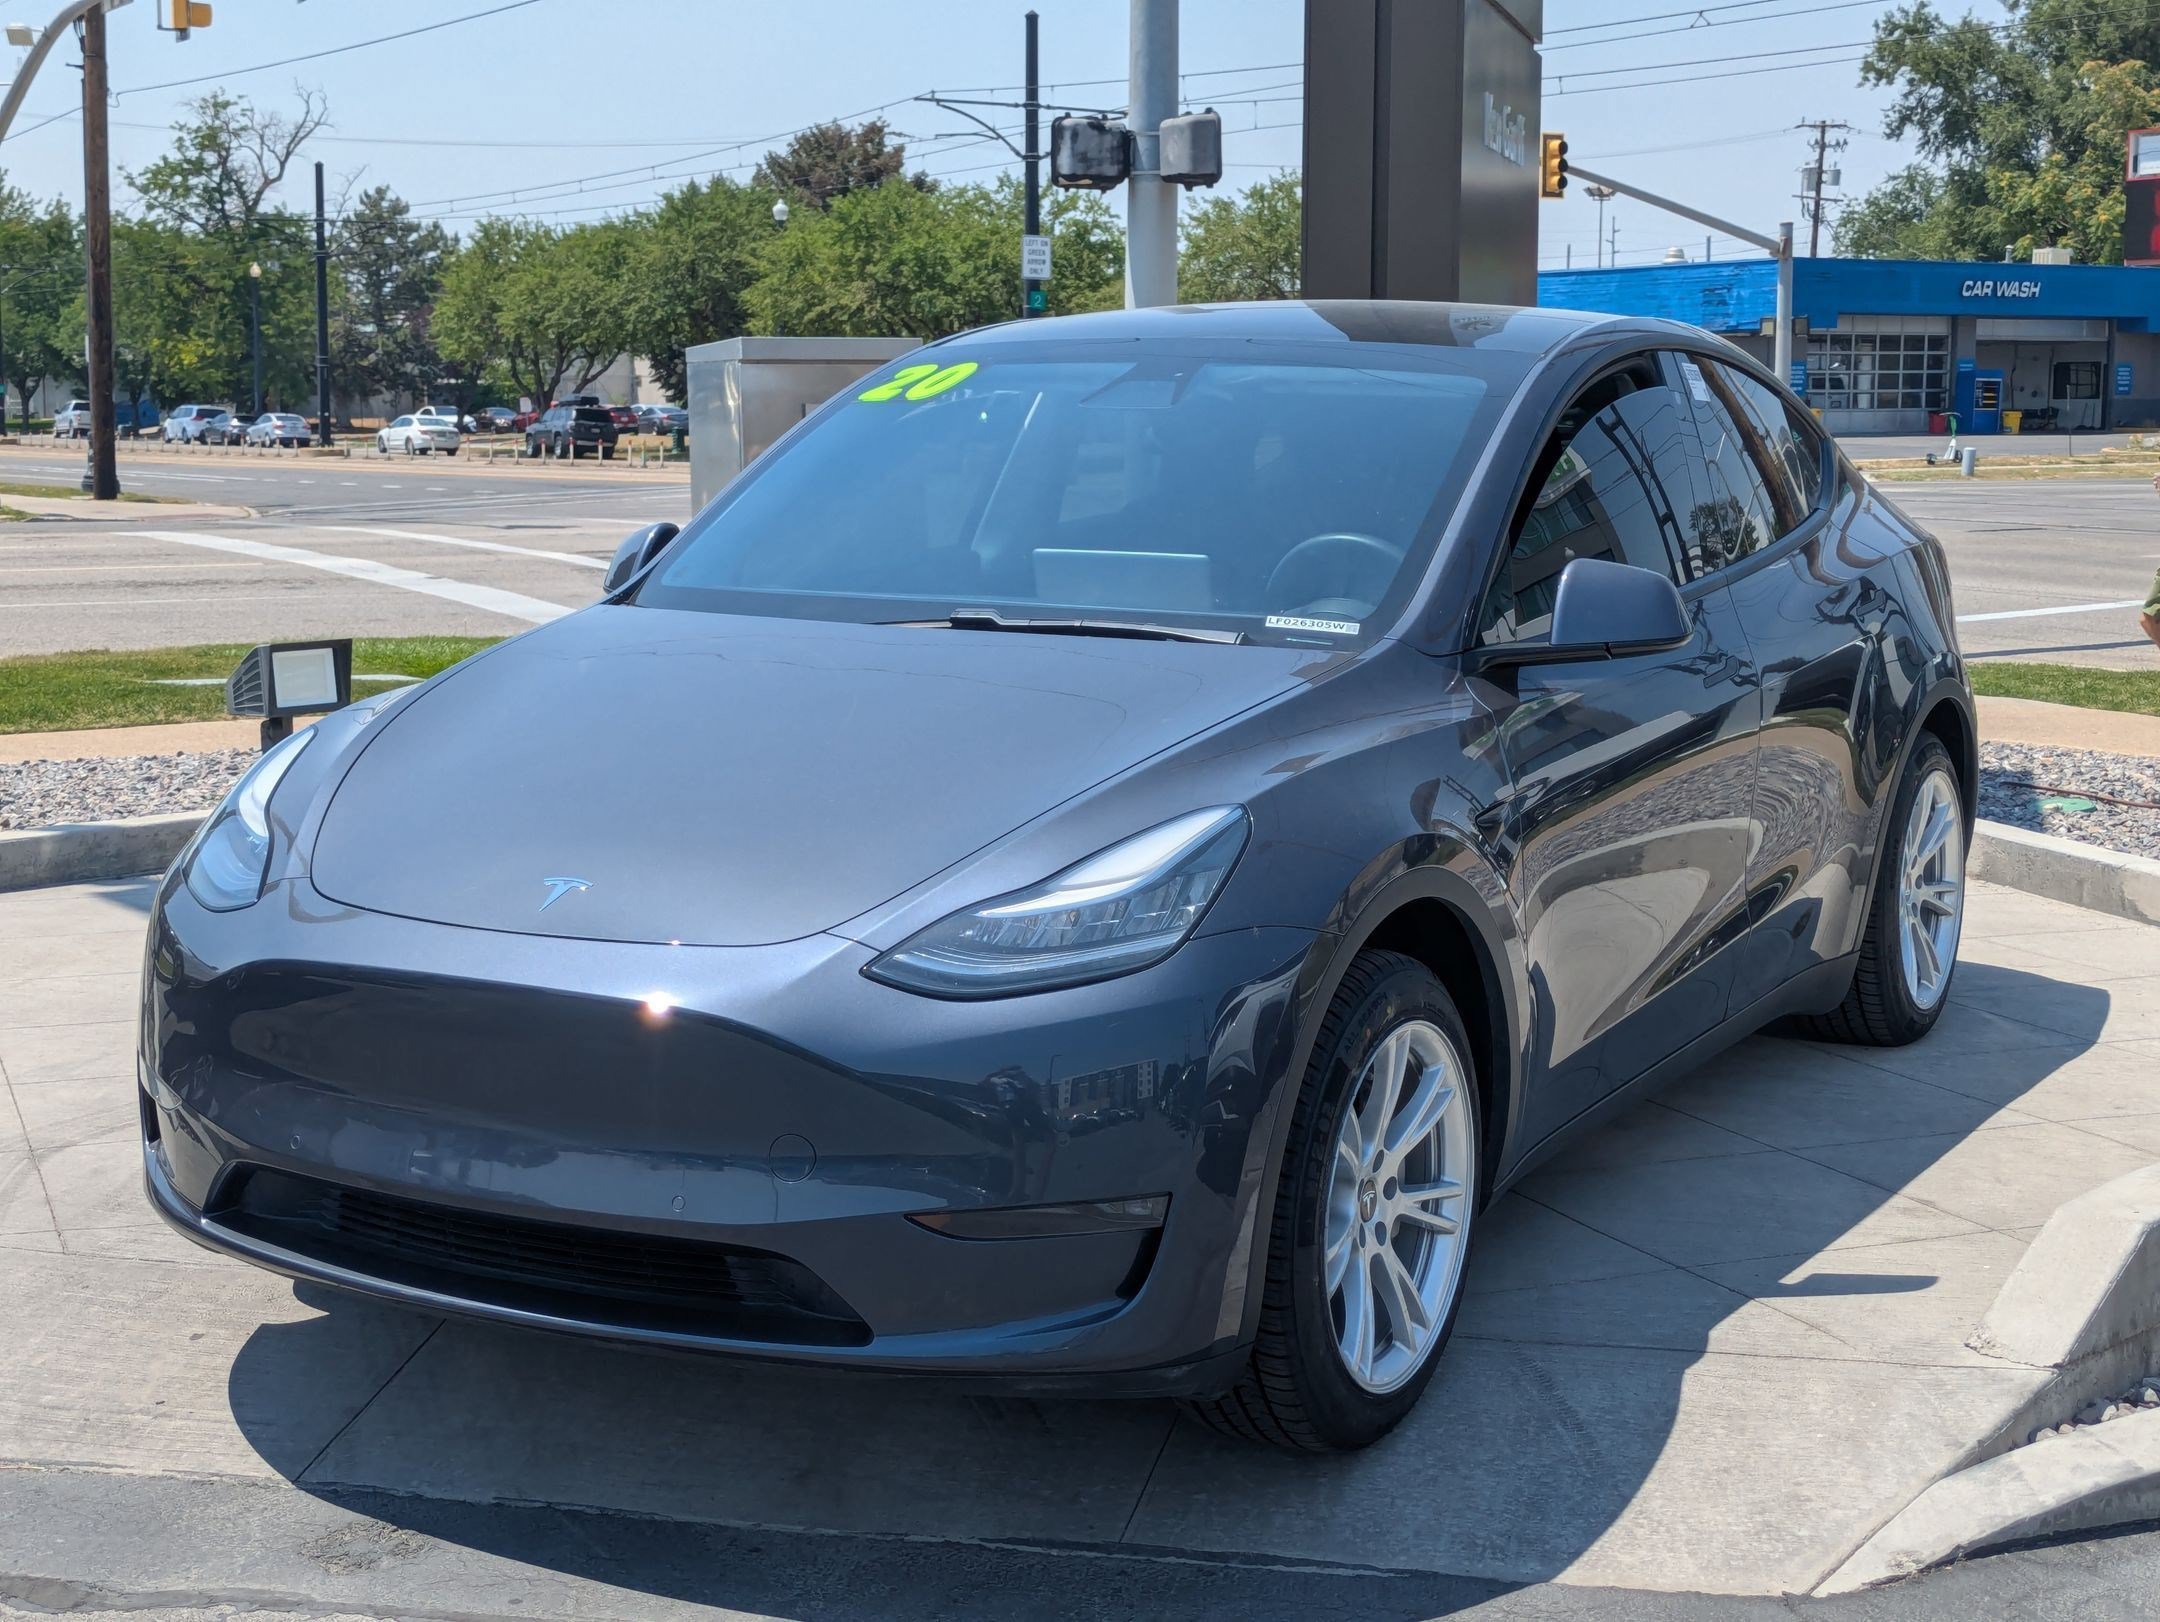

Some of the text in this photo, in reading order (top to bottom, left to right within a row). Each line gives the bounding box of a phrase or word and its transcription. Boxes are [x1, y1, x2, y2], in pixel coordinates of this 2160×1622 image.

[1027, 248, 1046, 256] GREEN
[1962, 280, 2041, 298] CAR WASH
[1033, 294, 1042, 307] 2
[857, 361, 979, 402] 20
[1267, 616, 1346, 631] LF026305W
